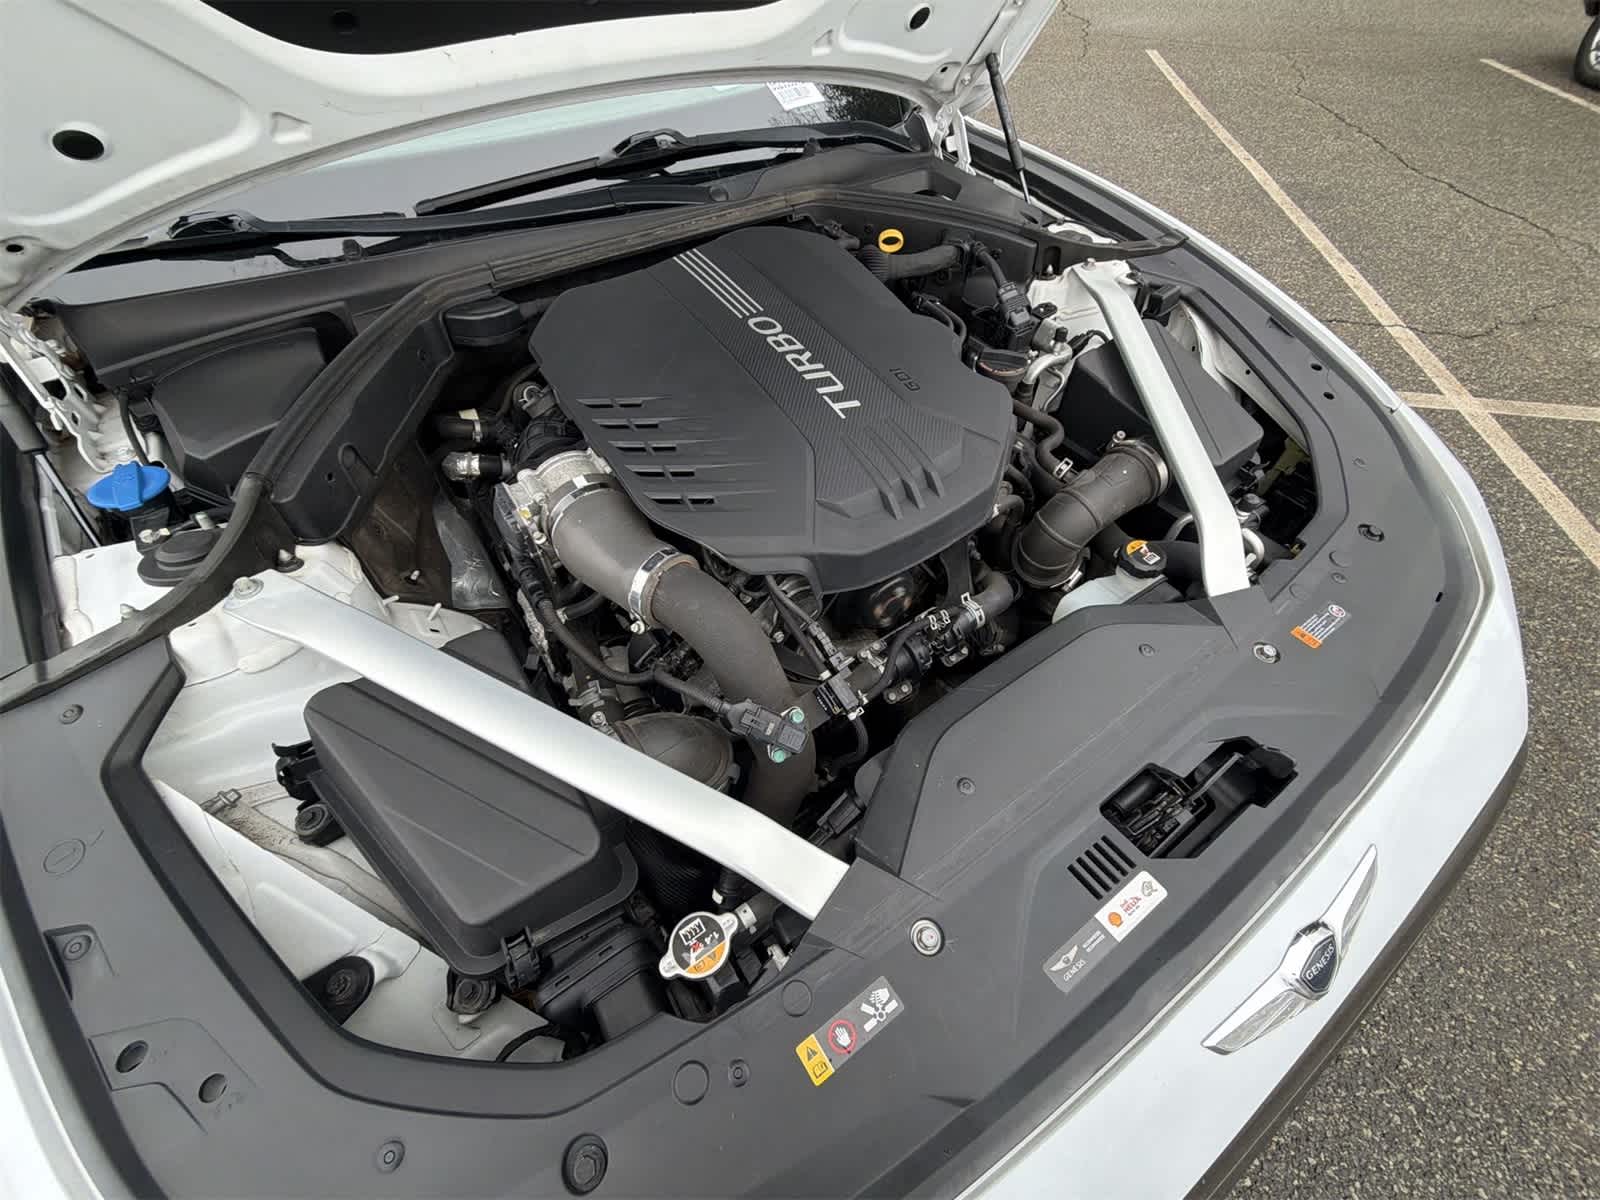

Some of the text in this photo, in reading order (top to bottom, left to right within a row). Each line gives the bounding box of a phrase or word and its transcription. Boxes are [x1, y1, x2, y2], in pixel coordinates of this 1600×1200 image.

[747, 316, 861, 419] TURBO
[888, 367, 921, 392] GDI
[1063, 959, 1088, 982] GENESIS
[1305, 943, 1335, 981] GENESIS
